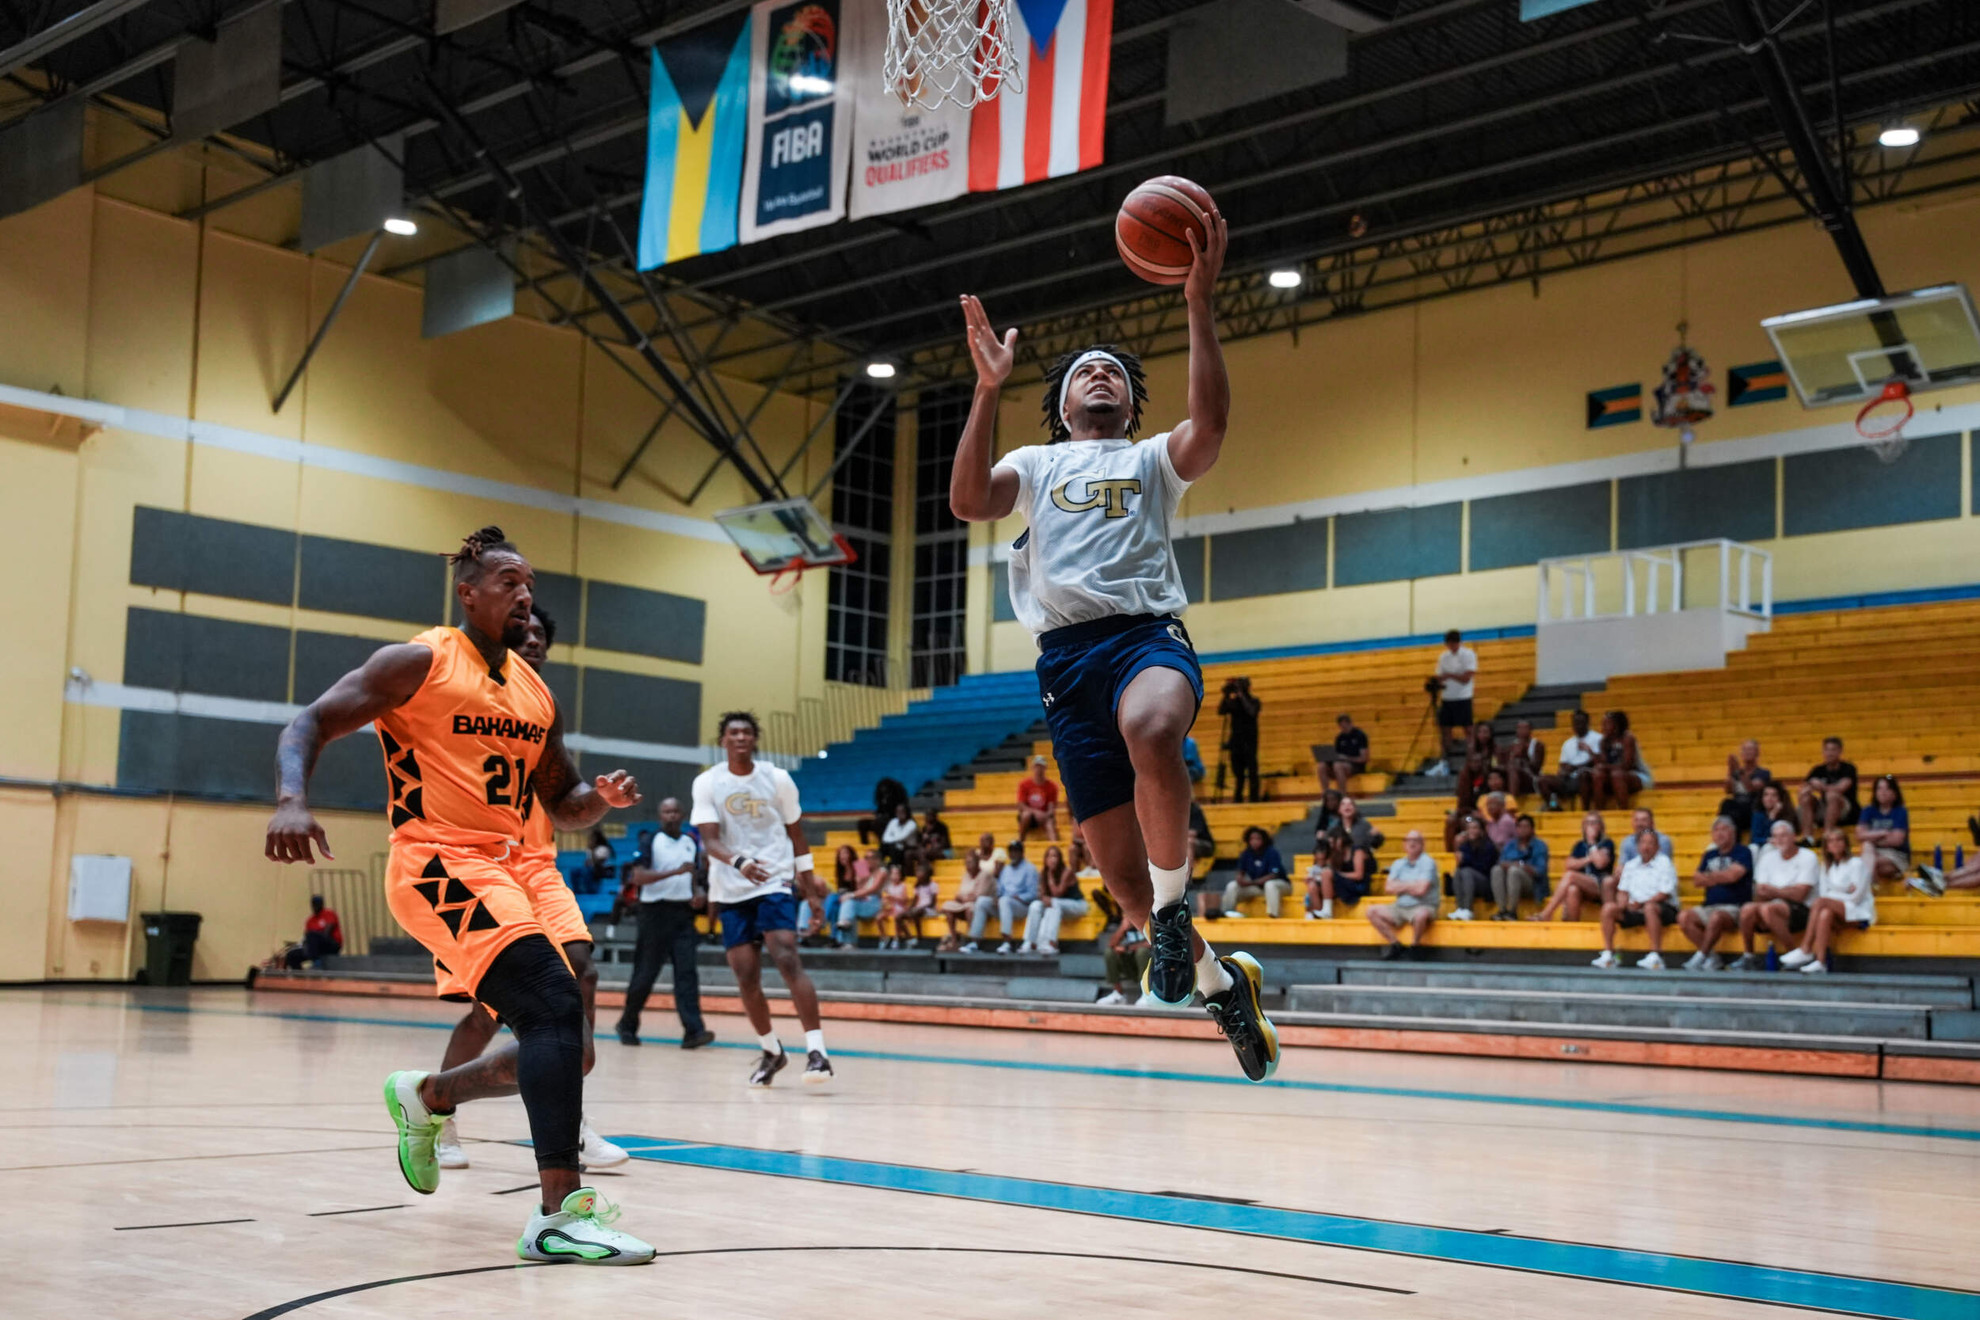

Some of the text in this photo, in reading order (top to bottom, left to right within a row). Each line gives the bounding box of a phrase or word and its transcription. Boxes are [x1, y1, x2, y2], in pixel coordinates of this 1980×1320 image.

[770, 119, 824, 169] FIBA
[868, 140, 921, 161] WORLD
[923, 131, 950, 151] CUP
[865, 149, 950, 188] QUALIFIERS
[1050, 467, 1142, 518] GT
[483, 755, 526, 810] 21
[725, 791, 768, 819] GT
